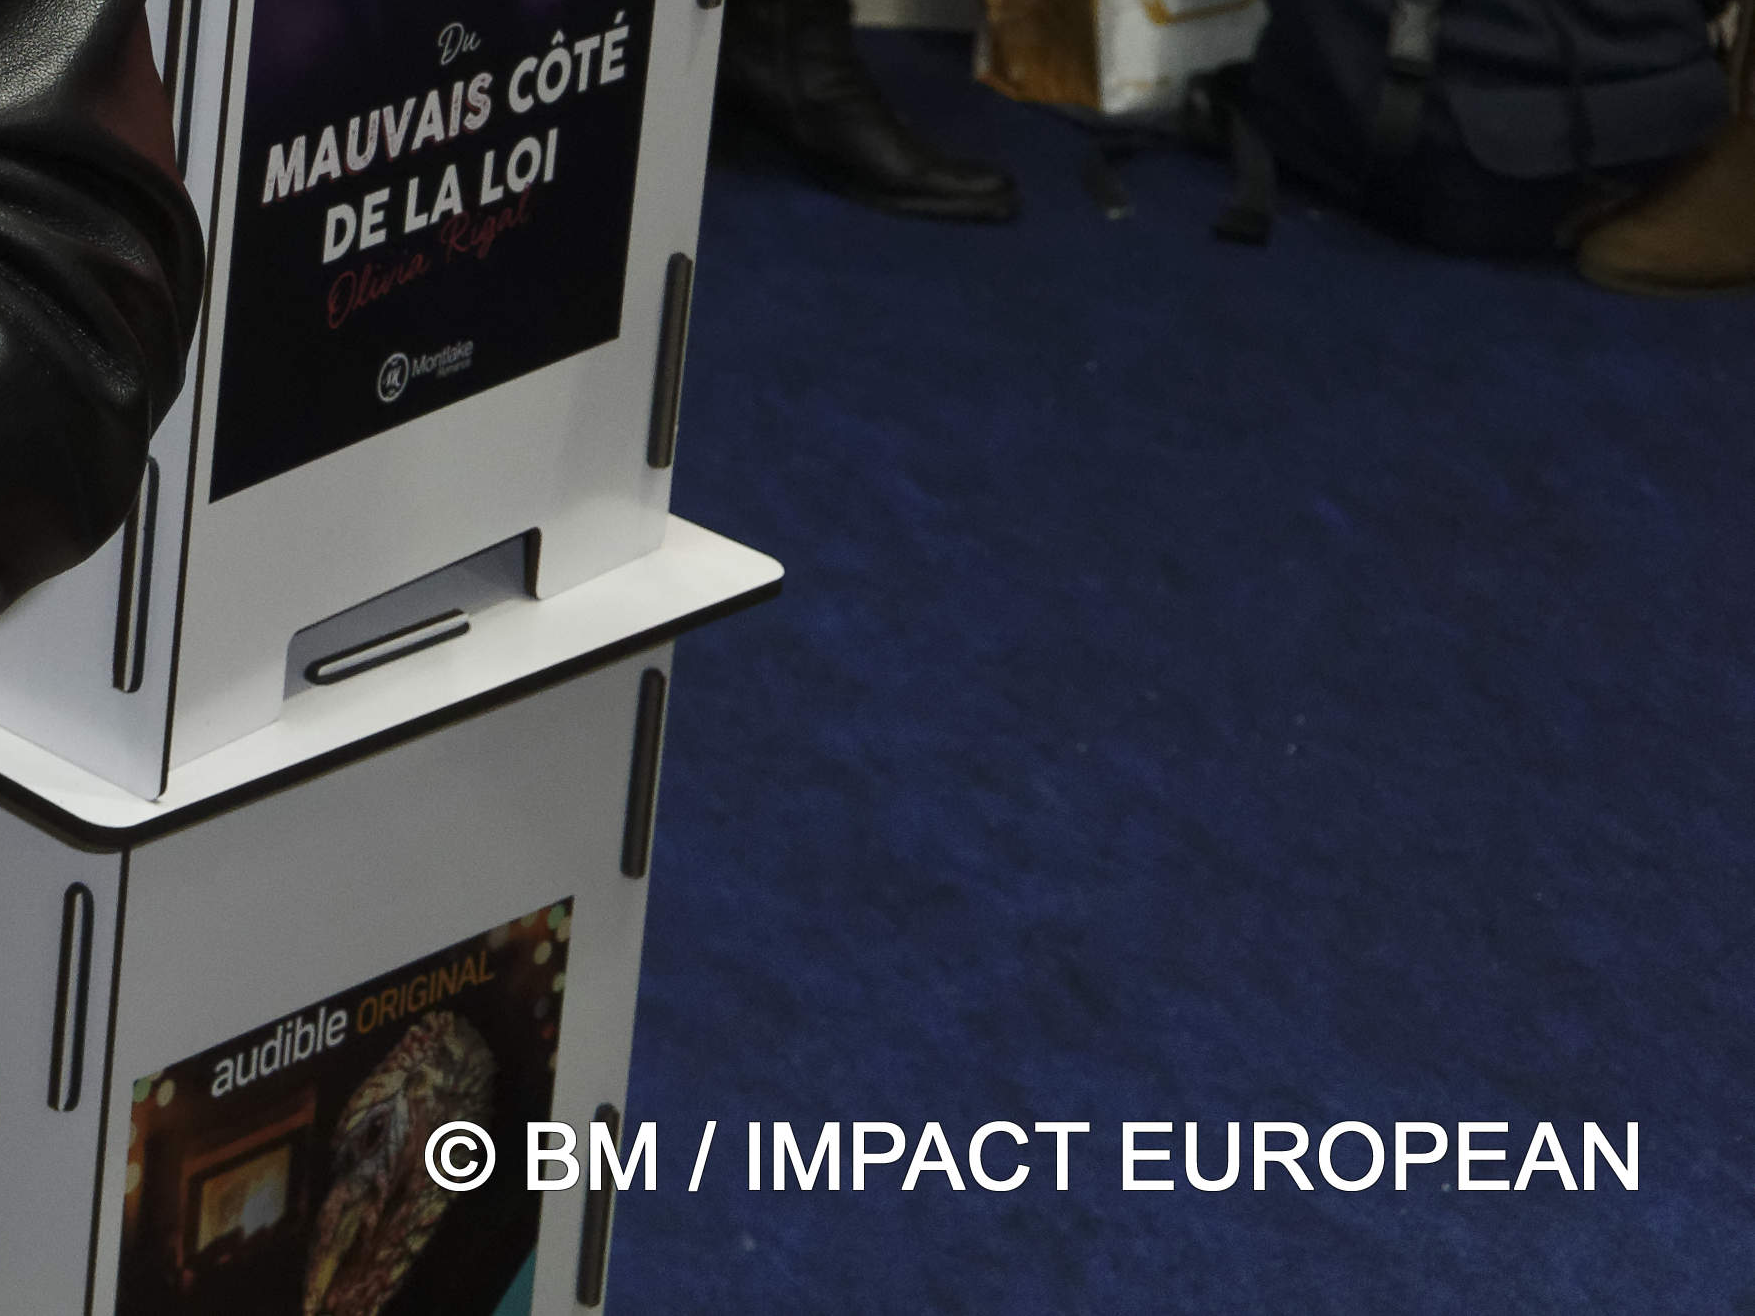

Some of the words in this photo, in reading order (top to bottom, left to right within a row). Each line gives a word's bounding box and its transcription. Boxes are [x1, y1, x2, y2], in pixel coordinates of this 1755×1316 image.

[260, 71, 494, 207] MAUVAIS
[507, 10, 631, 115] CÔTÉ
[437, 22, 481, 66] Du
[322, 186, 391, 265] DE
[403, 164, 464, 235] LA
[480, 128, 560, 207] LOI
[410, 339, 474, 378] Montlake
[210, 1006, 349, 1098] audible
[356, 950, 496, 1035] ORIGINAL
